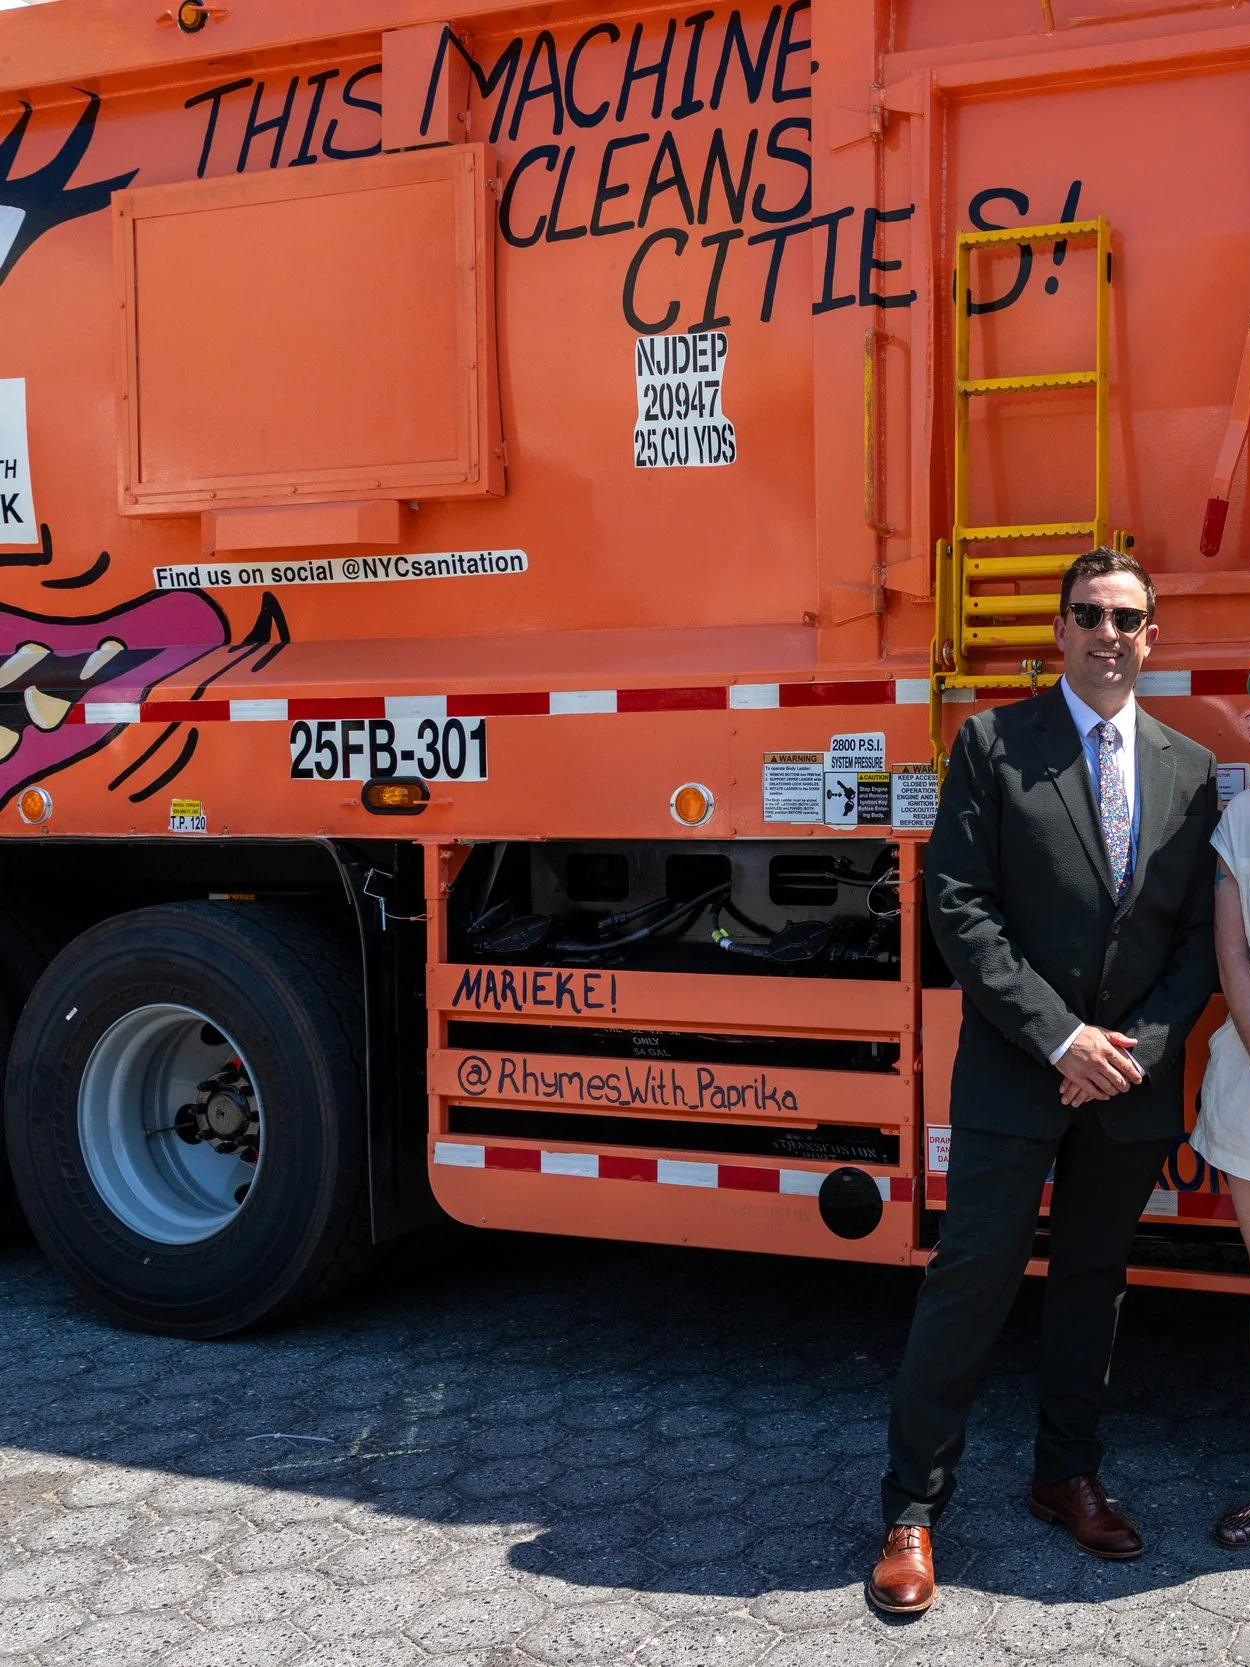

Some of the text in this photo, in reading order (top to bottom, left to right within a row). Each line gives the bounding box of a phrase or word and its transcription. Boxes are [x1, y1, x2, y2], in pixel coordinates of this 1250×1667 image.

[184, 1, 819, 178] THIS MACHINE
[500, 117, 812, 248] CLEANS
[637, 333, 728, 376] NJDEP
[643, 380, 720, 421] 20947
[634, 423, 736, 467] 25 CU YDS
[157, 551, 524, 588] Find us on social @NYCsanitation
[289, 718, 487, 780] 25FB-301
[779, 755, 818, 763] WARNING
[831, 756, 883, 769] SYSTEM PRESSURE
[832, 738, 883, 751] 2800 P.S.I.
[171, 816, 206, 830] T.P. 120
[451, 967, 618, 1014] MARIEKE!
[632, 1036, 660, 1046] ONLY
